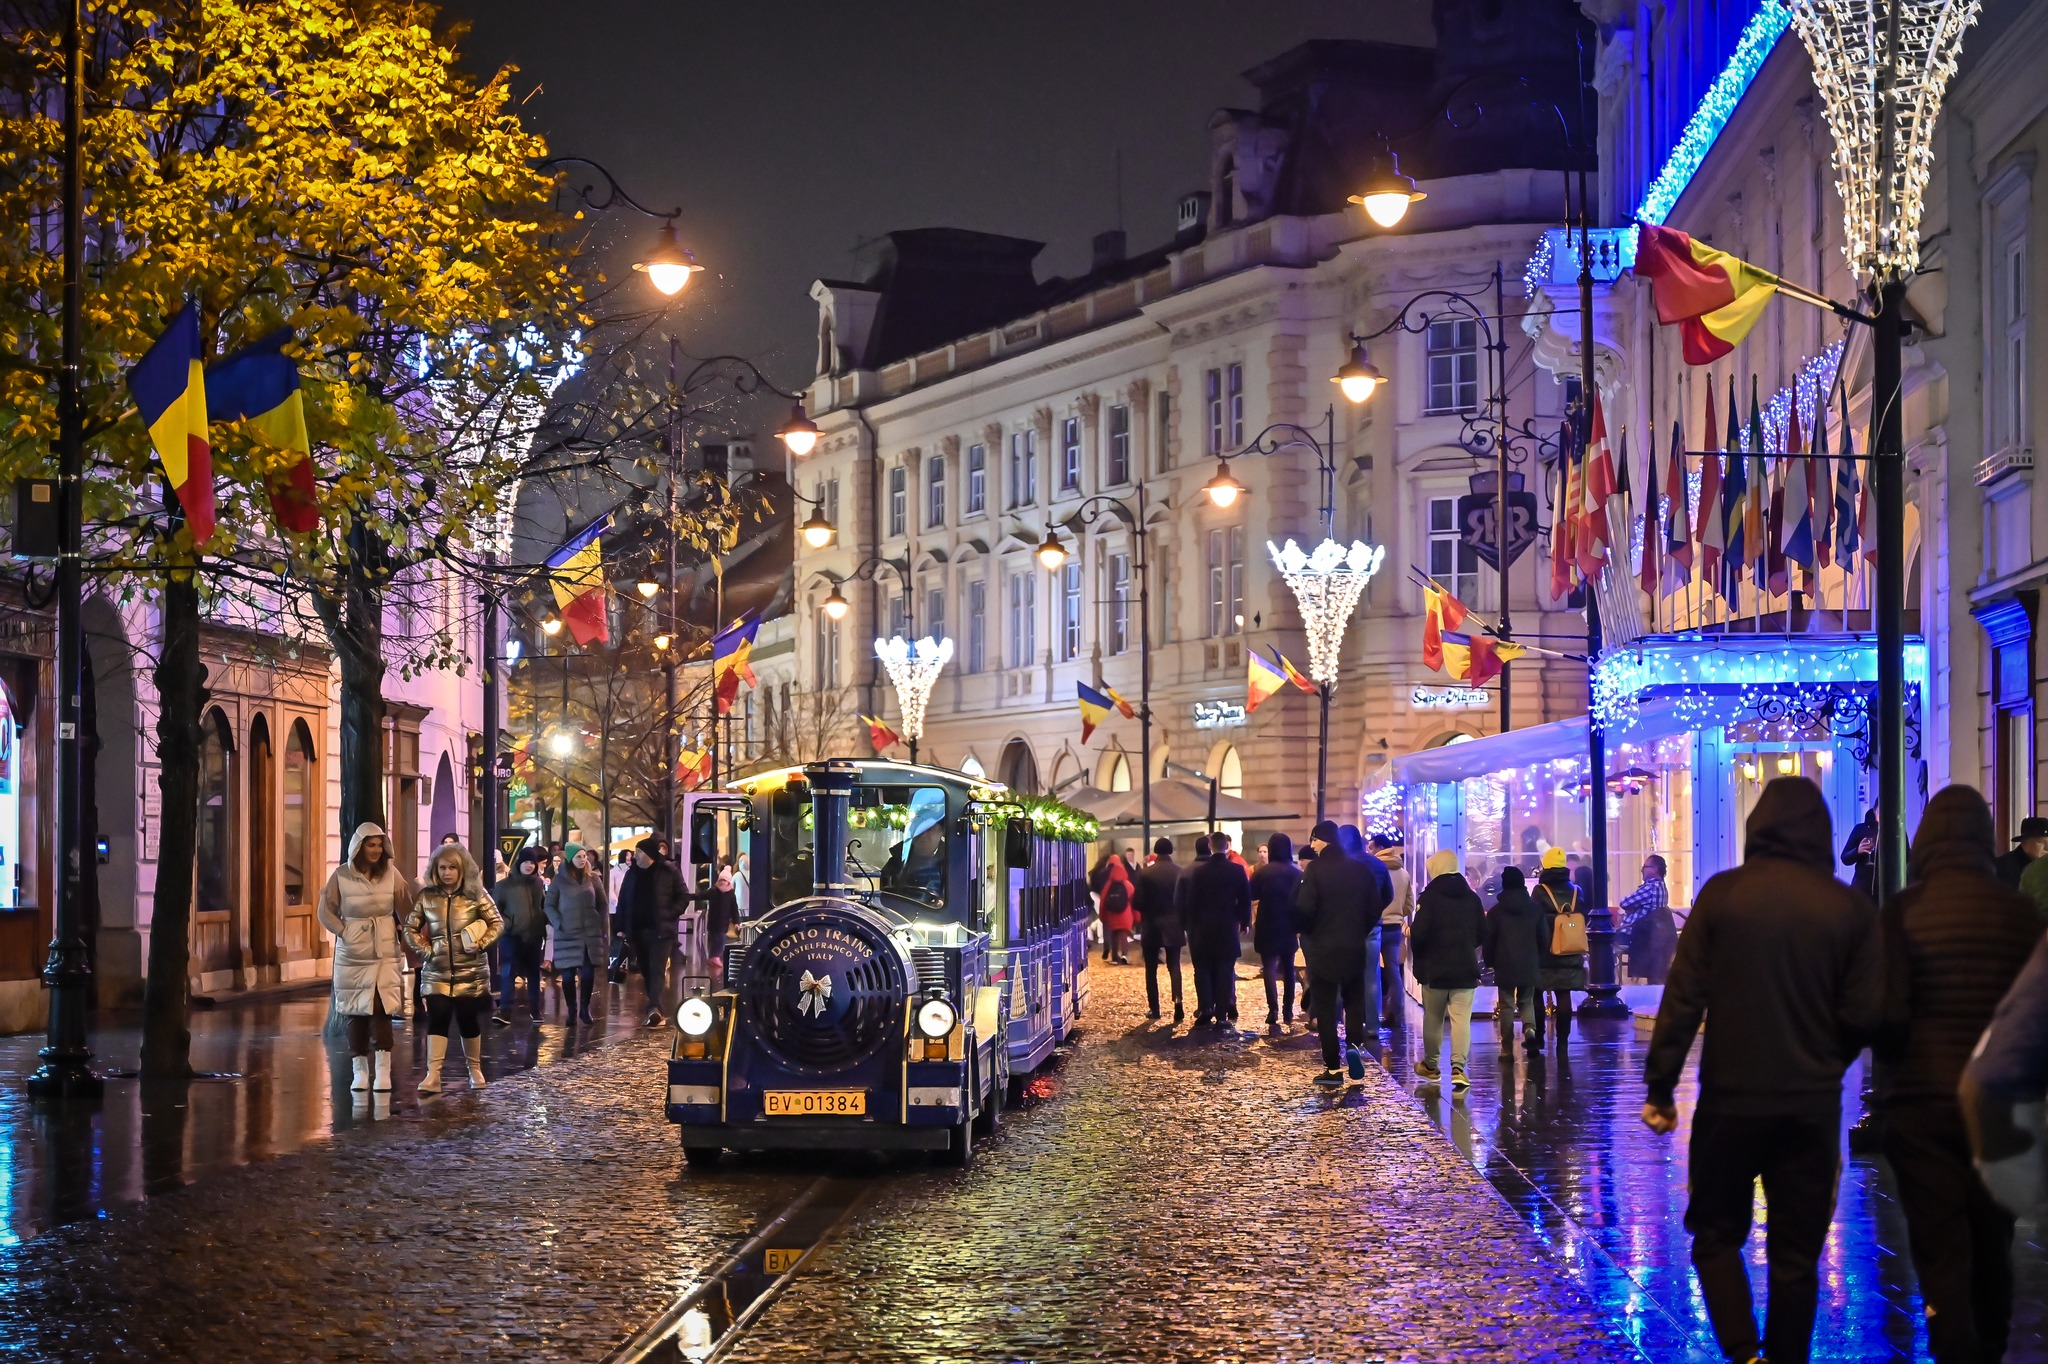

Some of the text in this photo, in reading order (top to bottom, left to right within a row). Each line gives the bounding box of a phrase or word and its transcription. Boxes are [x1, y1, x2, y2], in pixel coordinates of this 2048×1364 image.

[771, 928, 873, 958] DOTTO TRAINS
[782, 942, 853, 962] CASTELFRANCO
[807, 953, 834, 961] ITALY
[769, 1096, 860, 1111] BV 01384
